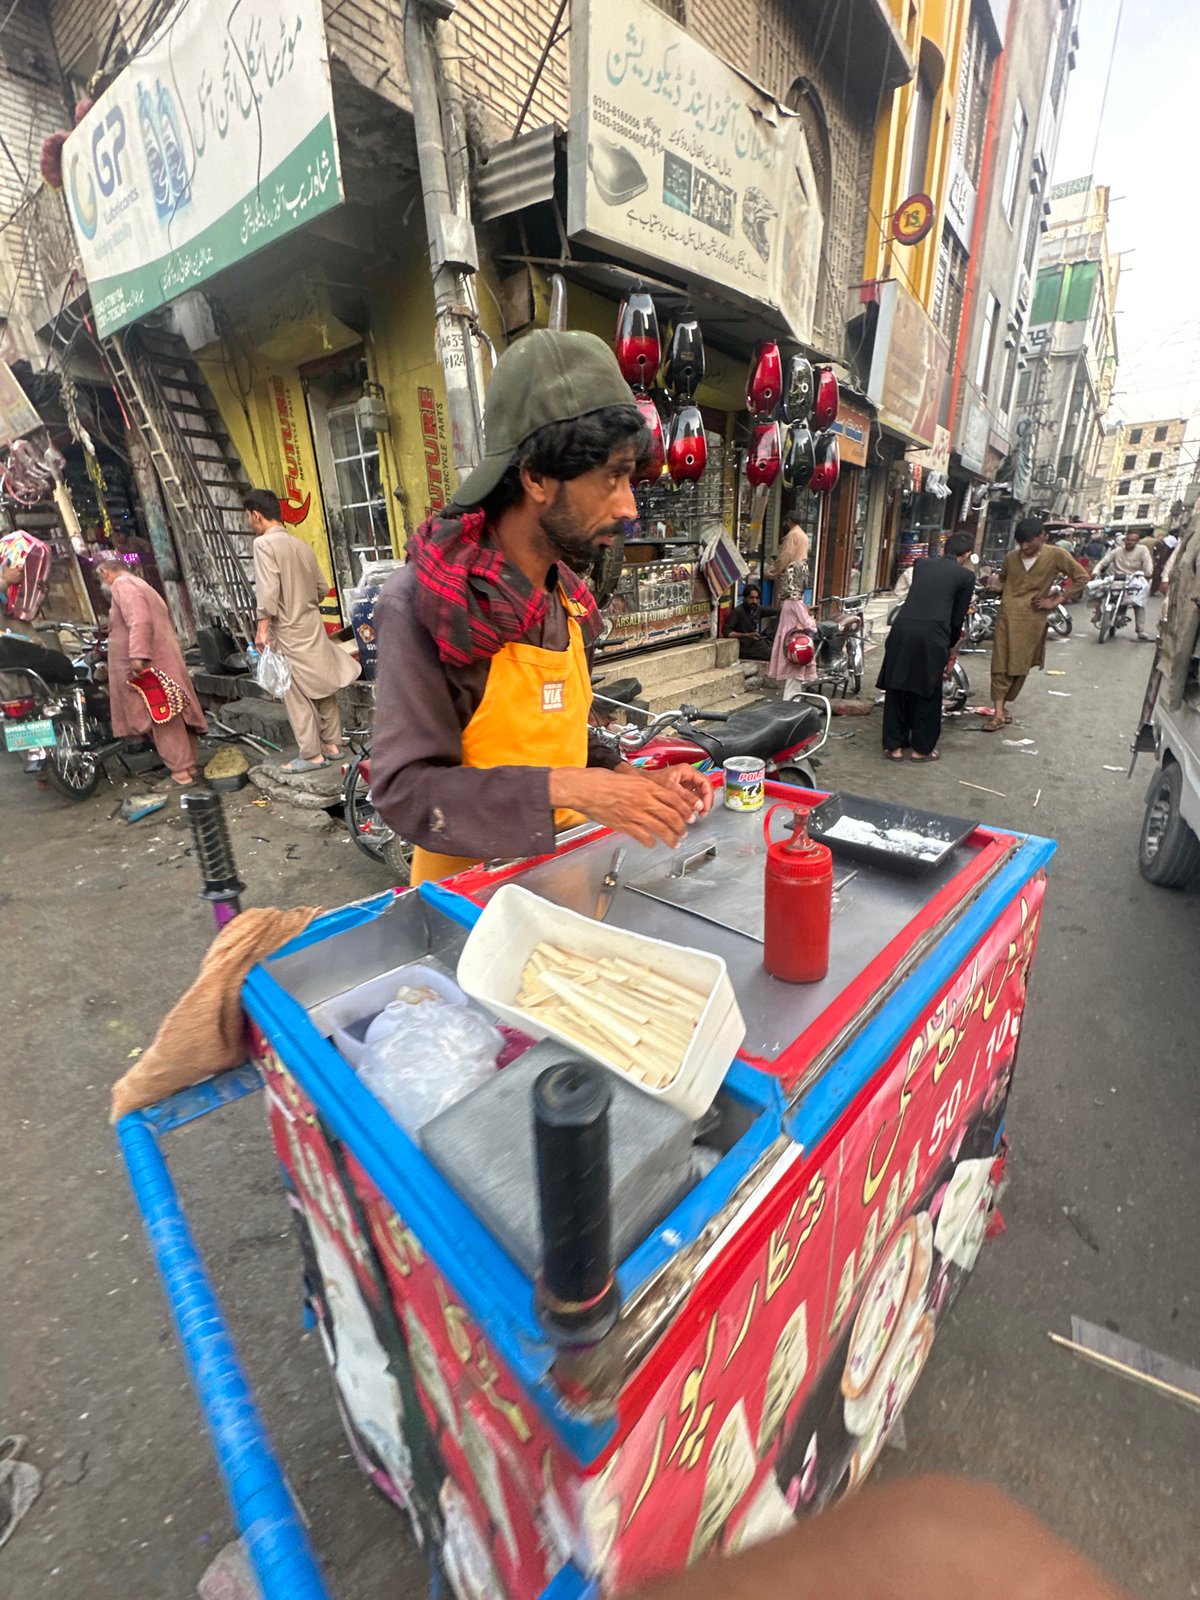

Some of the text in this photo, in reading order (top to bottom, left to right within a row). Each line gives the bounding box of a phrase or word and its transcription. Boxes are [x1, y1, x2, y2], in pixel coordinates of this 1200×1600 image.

[92, 105, 126, 197] GP
[270, 374, 304, 505] FUTURE
[436, 401, 453, 505] OTORCYCLE PARTS
[928, 1078, 963, 1157] 50
